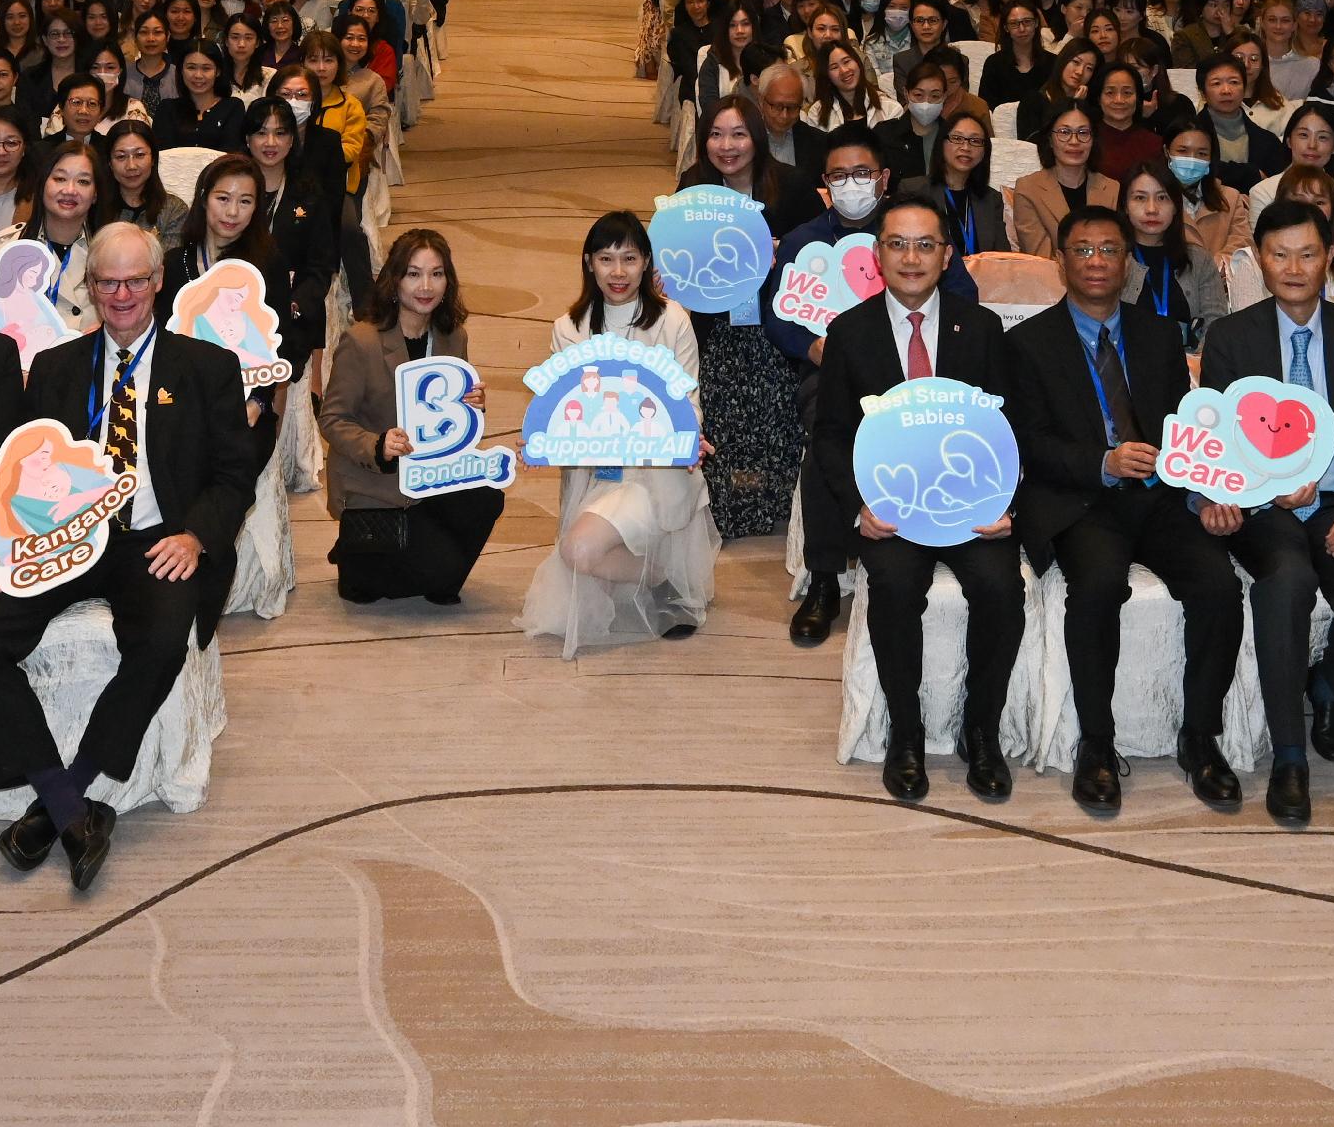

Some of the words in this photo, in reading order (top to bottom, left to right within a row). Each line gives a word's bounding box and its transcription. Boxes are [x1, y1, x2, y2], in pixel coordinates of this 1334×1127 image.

[655, 193, 693, 211] Best
[698, 192, 735, 207] Start
[740, 196, 765, 213] for
[684, 209, 734, 222] Babies
[785, 269, 828, 300] We
[778, 293, 840, 327] Care
[528, 337, 695, 397] Breastfeeding
[913, 386, 965, 405] Start
[970, 388, 1002, 410] for
[901, 408, 966, 427] Babies
[529, 433, 619, 458] Support
[624, 436, 656, 455] for
[661, 432, 693, 454] All
[1171, 423, 1223, 458] We
[407, 453, 501, 486] Bonding
[1164, 451, 1245, 492] Care
[13, 474, 136, 562] Kangaroo
[13, 544, 92, 587] Care
